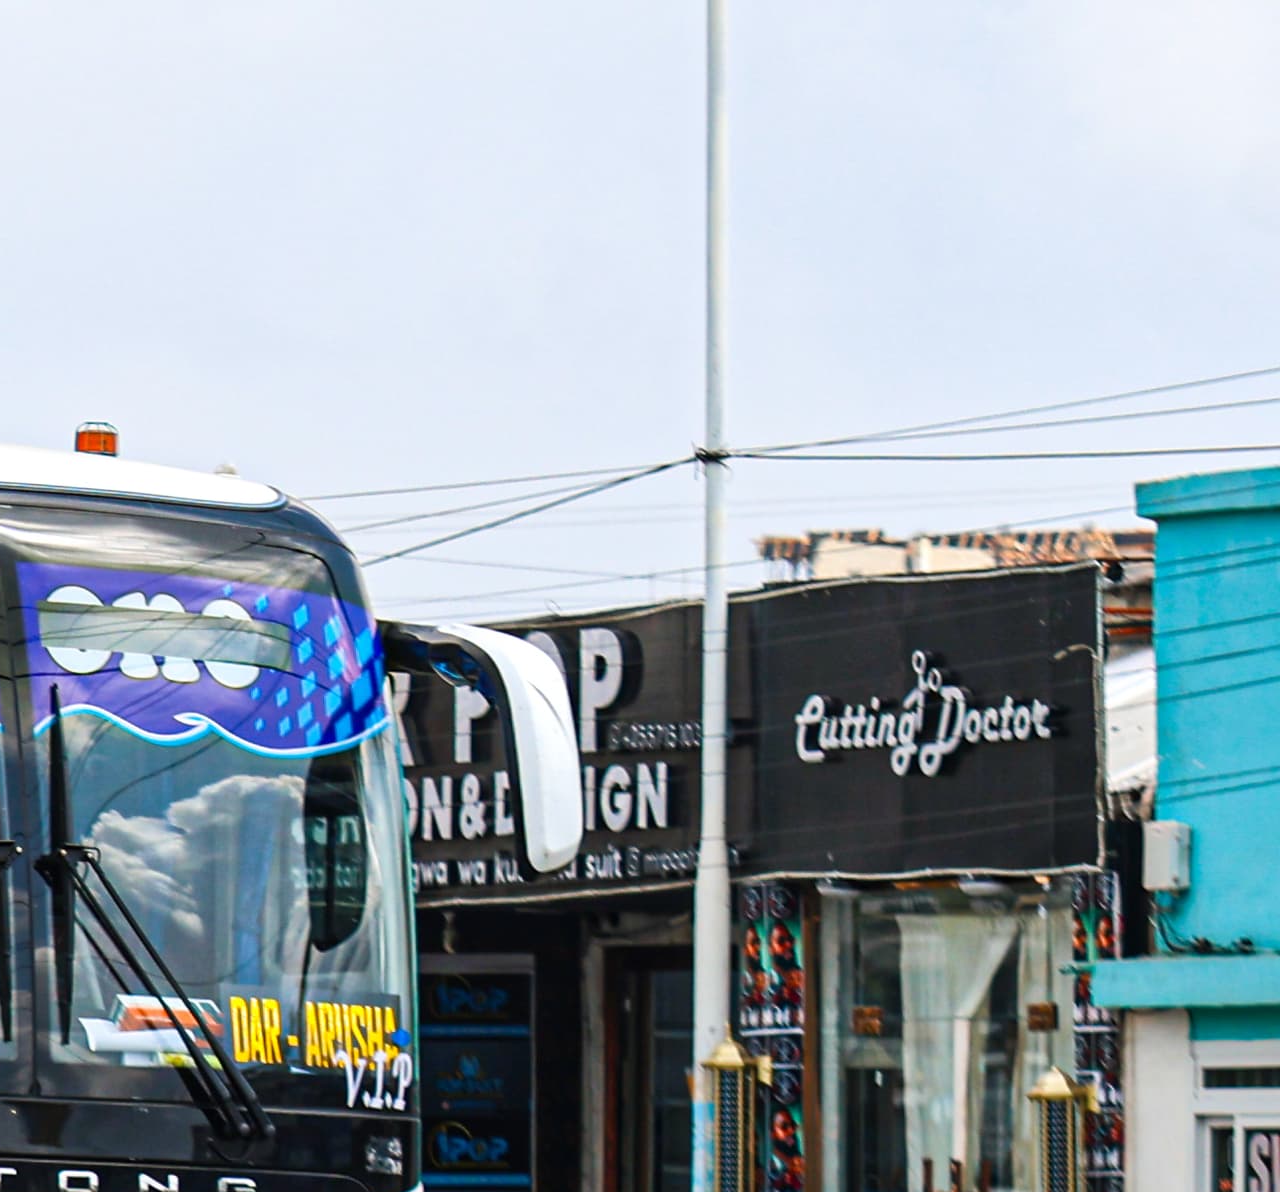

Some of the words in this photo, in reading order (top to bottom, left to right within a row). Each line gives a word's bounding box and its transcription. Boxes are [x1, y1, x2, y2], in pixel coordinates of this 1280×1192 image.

[454, 628, 623, 763] PP
[794, 693, 918, 777] Cutting
[918, 686, 1052, 777] Doctor
[584, 844, 624, 881] suit
[229, 996, 283, 1064] DAR
